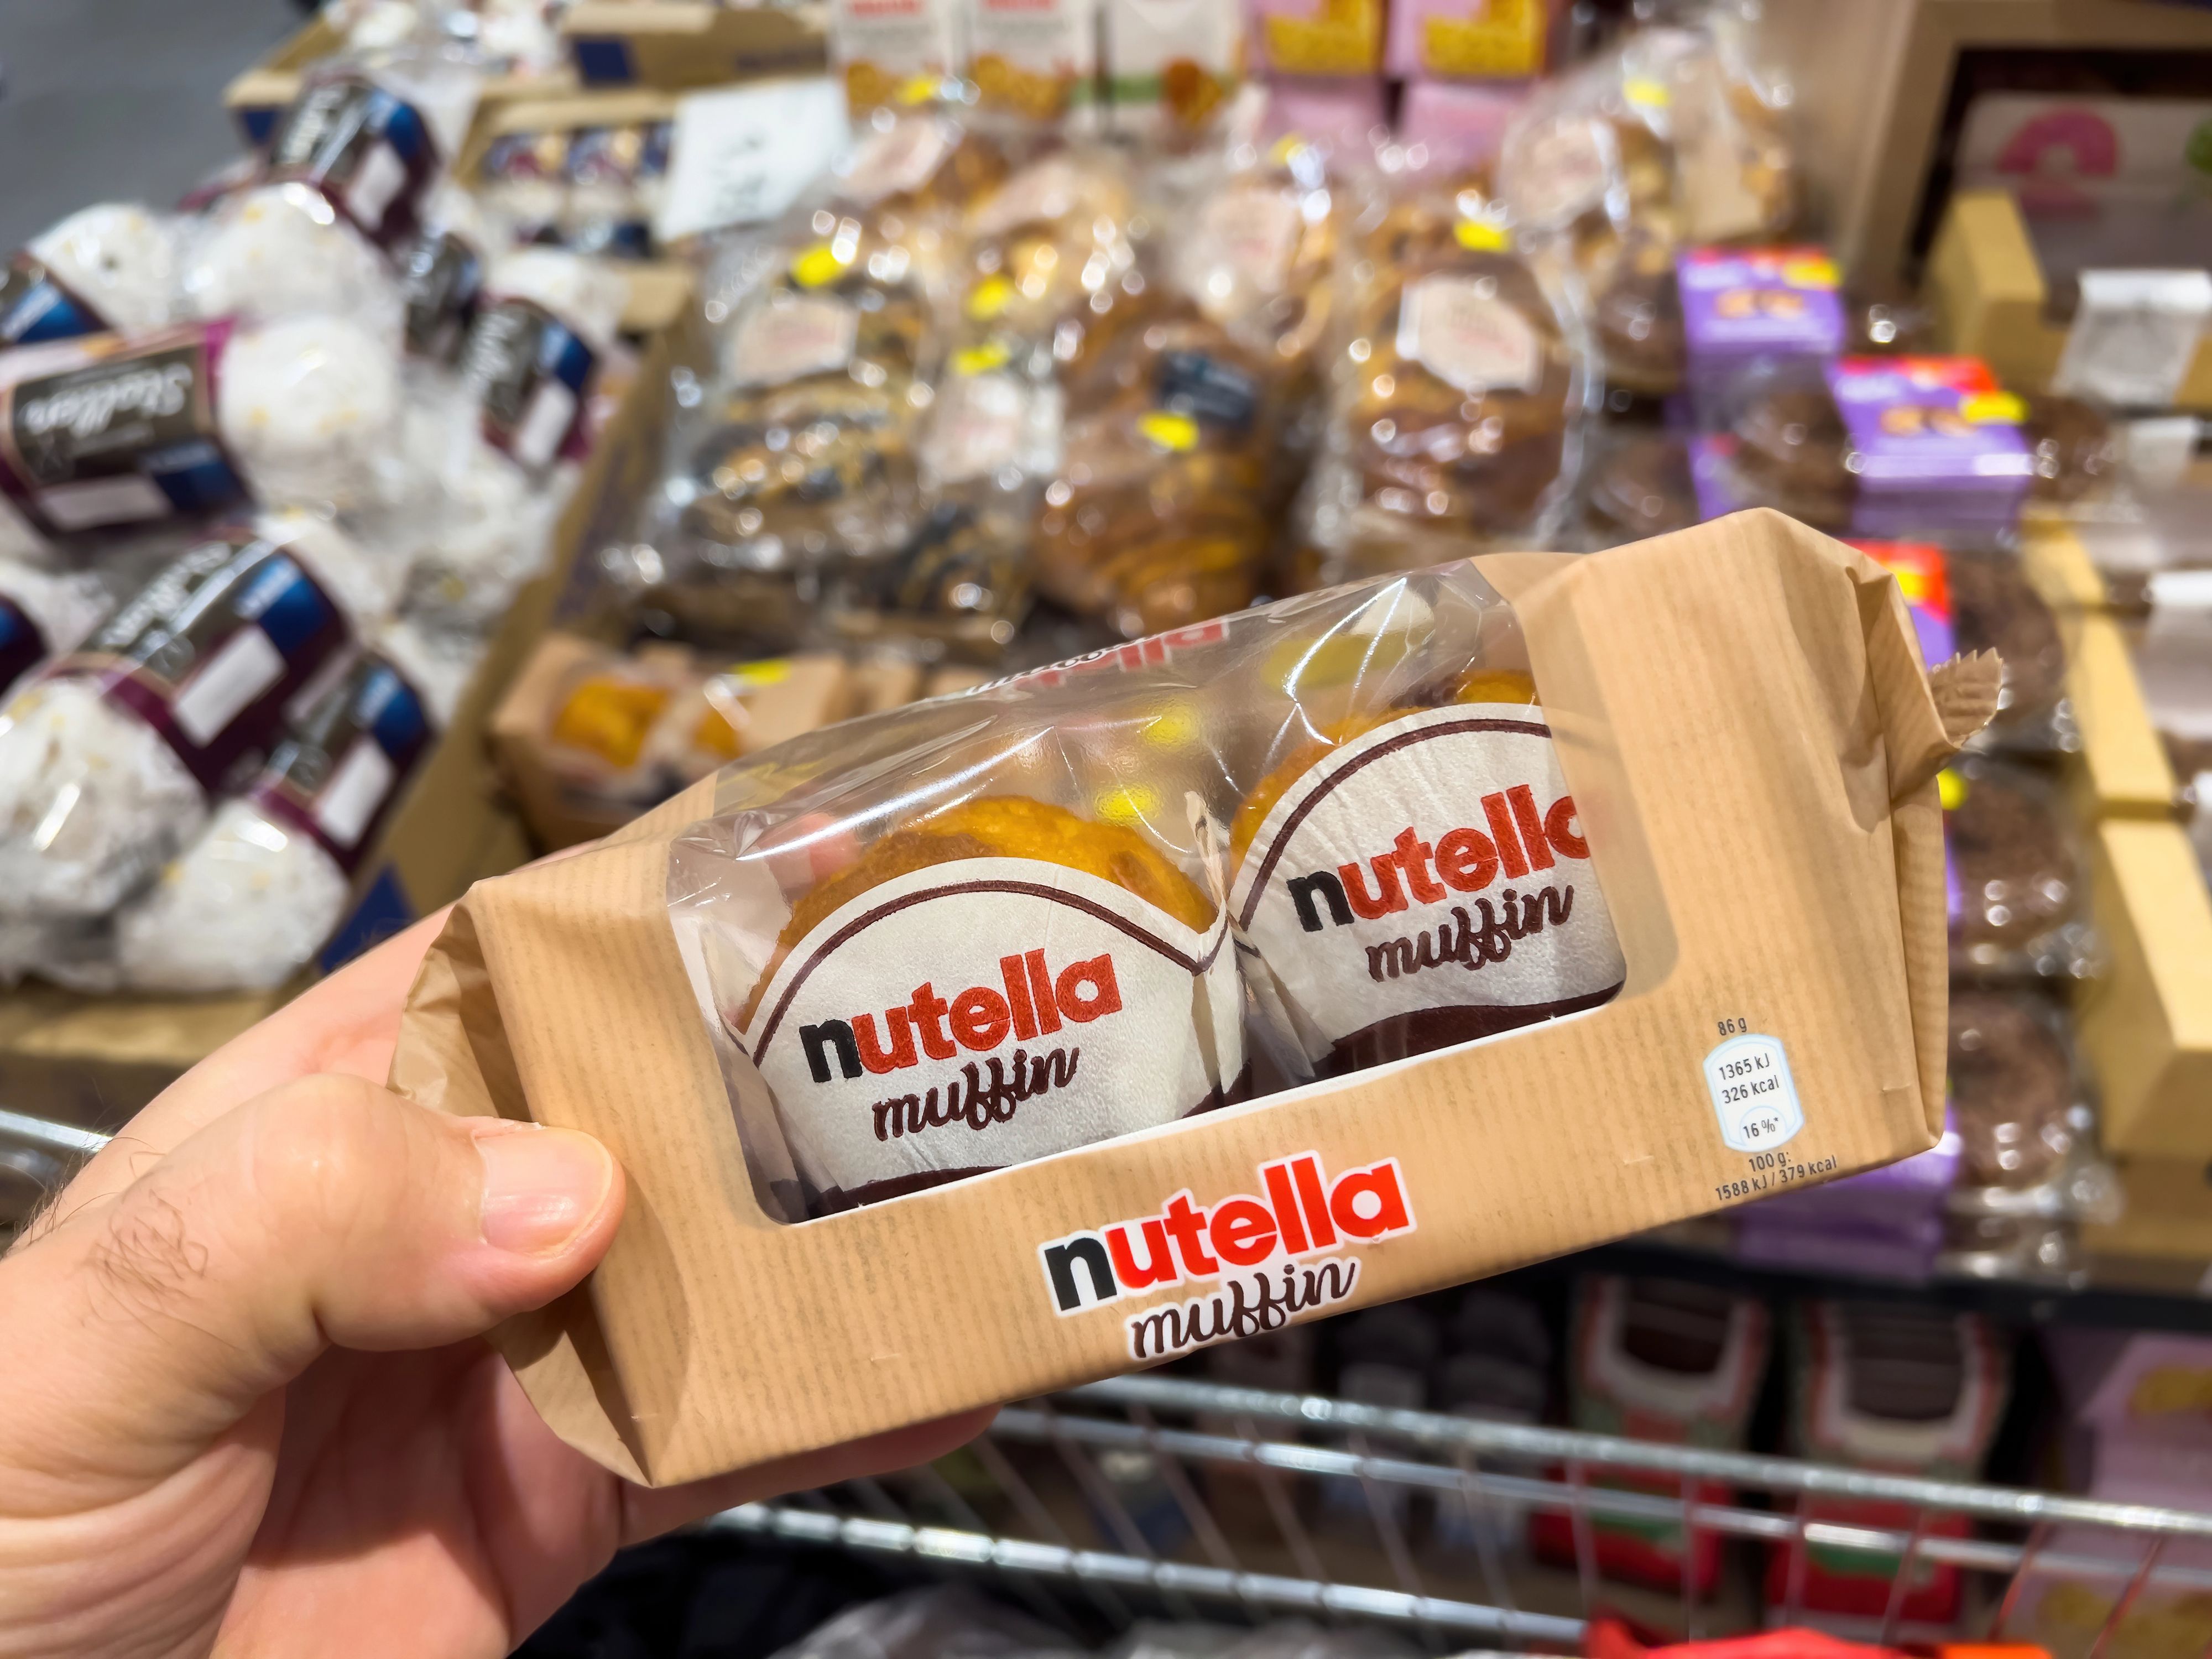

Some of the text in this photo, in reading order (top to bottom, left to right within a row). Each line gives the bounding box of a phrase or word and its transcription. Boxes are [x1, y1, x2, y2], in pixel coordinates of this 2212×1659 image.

[1365, 885, 1574, 983] muffin
[799, 948, 1123, 1083] nutella
[1717, 1018, 1747, 1036] 86 g
[1719, 1053, 1770, 1080] 1365 kJ
[1721, 1075, 1780, 1104] 326 kcal
[872, 1047, 1079, 1141] muffin
[1743, 1123, 1760, 1139] 16
[1715, 1180, 1749, 1201] 1588
[1752, 1174, 1767, 1192] kJ
[1779, 1164, 1805, 1183] 379
[1808, 1155, 1837, 1175] kcal
[1749, 1151, 1791, 1172] 100 g:
[1044, 1156, 1409, 1311] nutella
[1131, 1262, 1356, 1358] muffin
